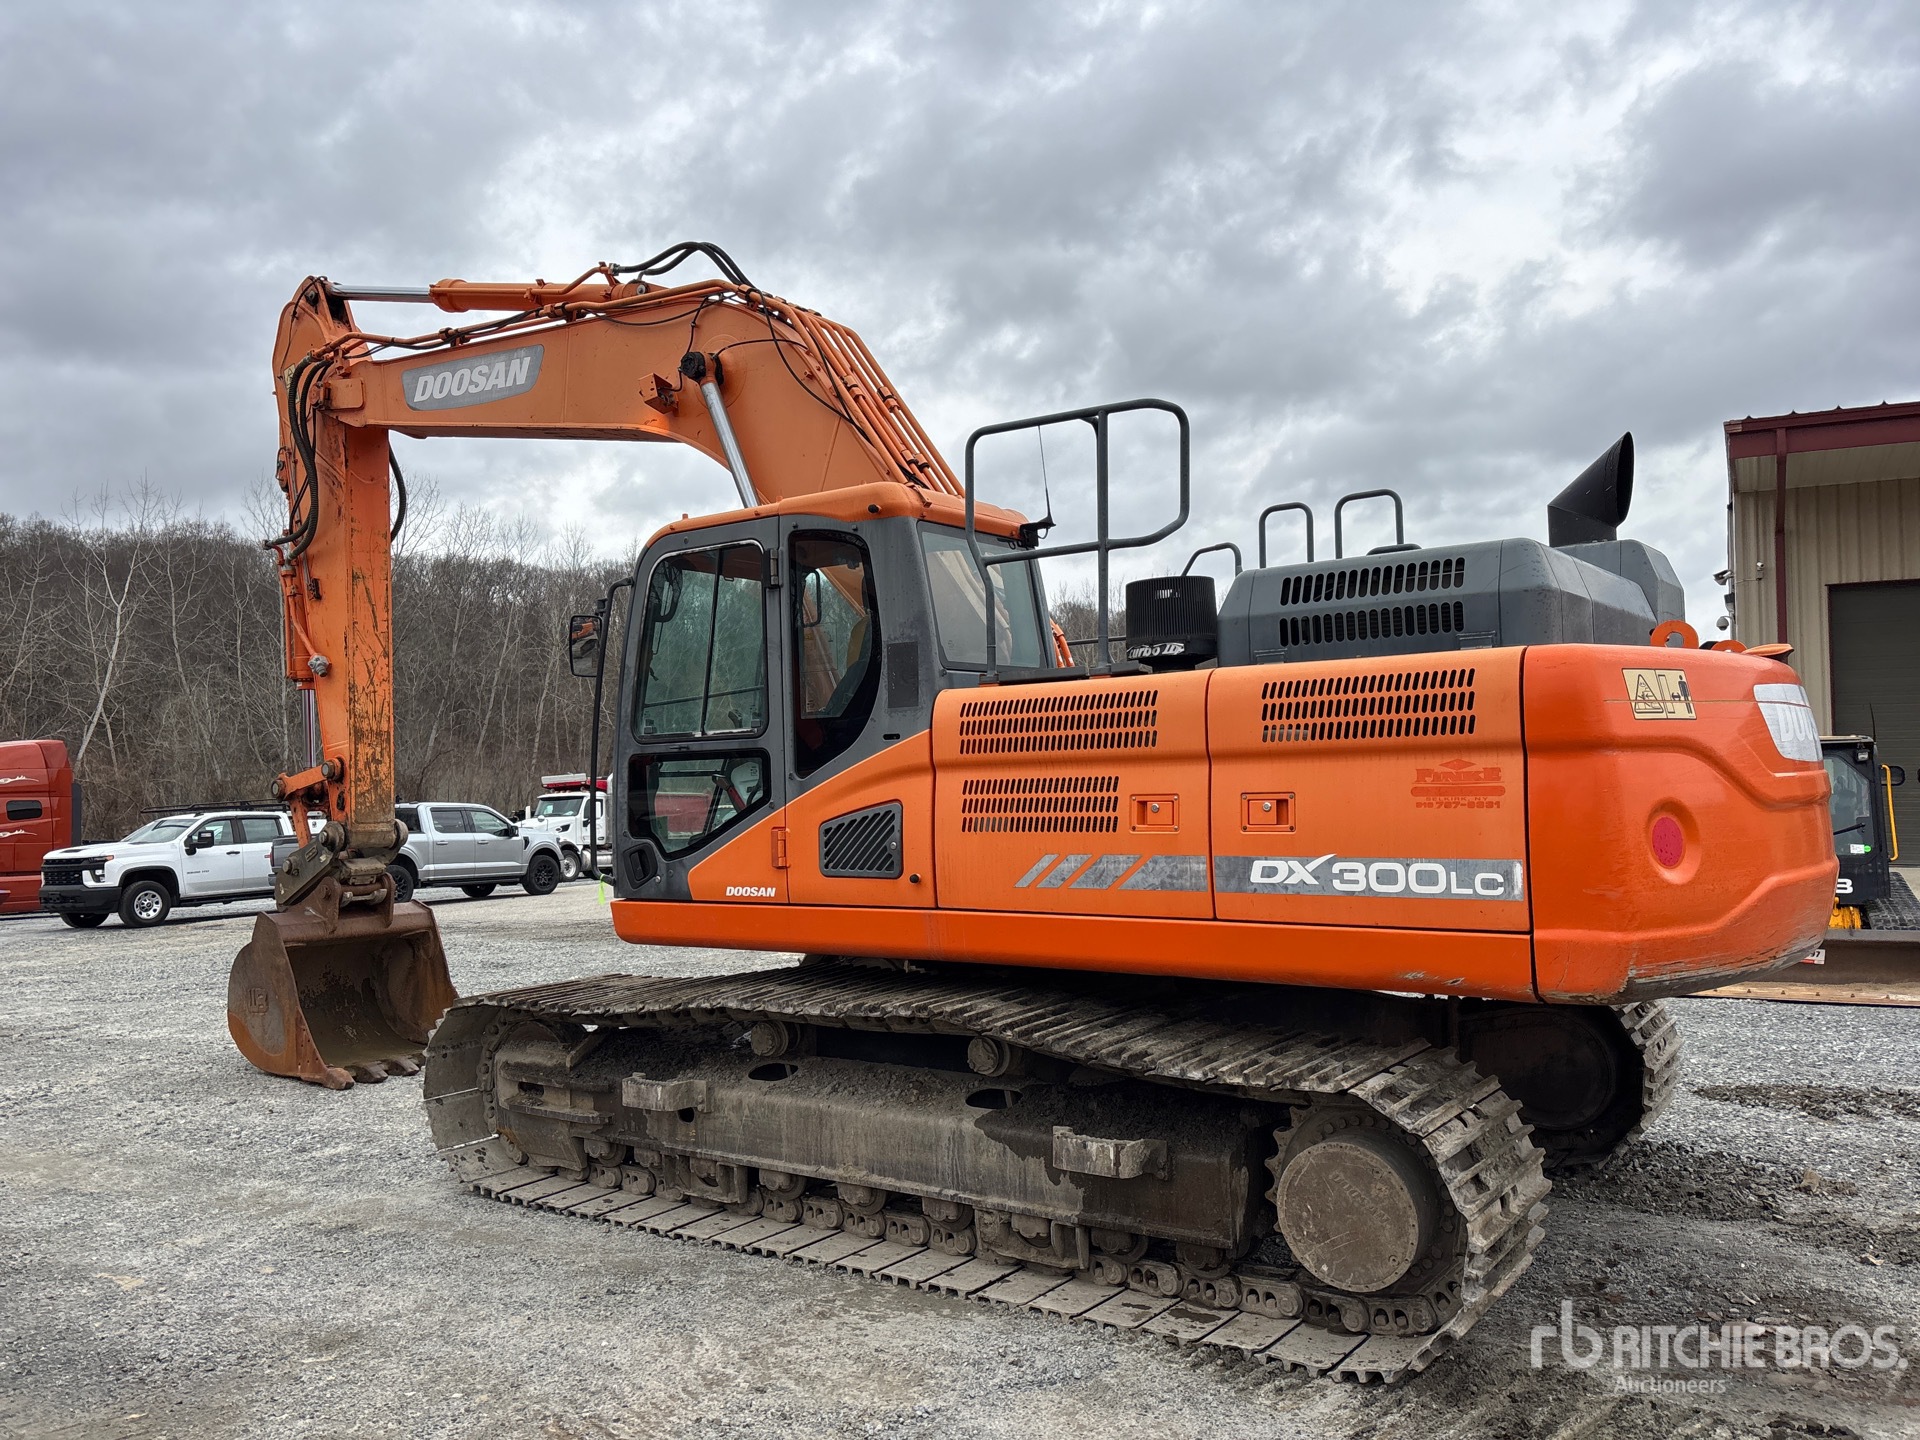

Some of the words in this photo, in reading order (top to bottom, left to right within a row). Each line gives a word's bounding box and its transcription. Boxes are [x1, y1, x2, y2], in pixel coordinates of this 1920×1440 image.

[413, 356, 531, 403] DOOSAN
[1415, 767, 1502, 783] FINKE
[725, 886, 777, 898] DOOSAN
